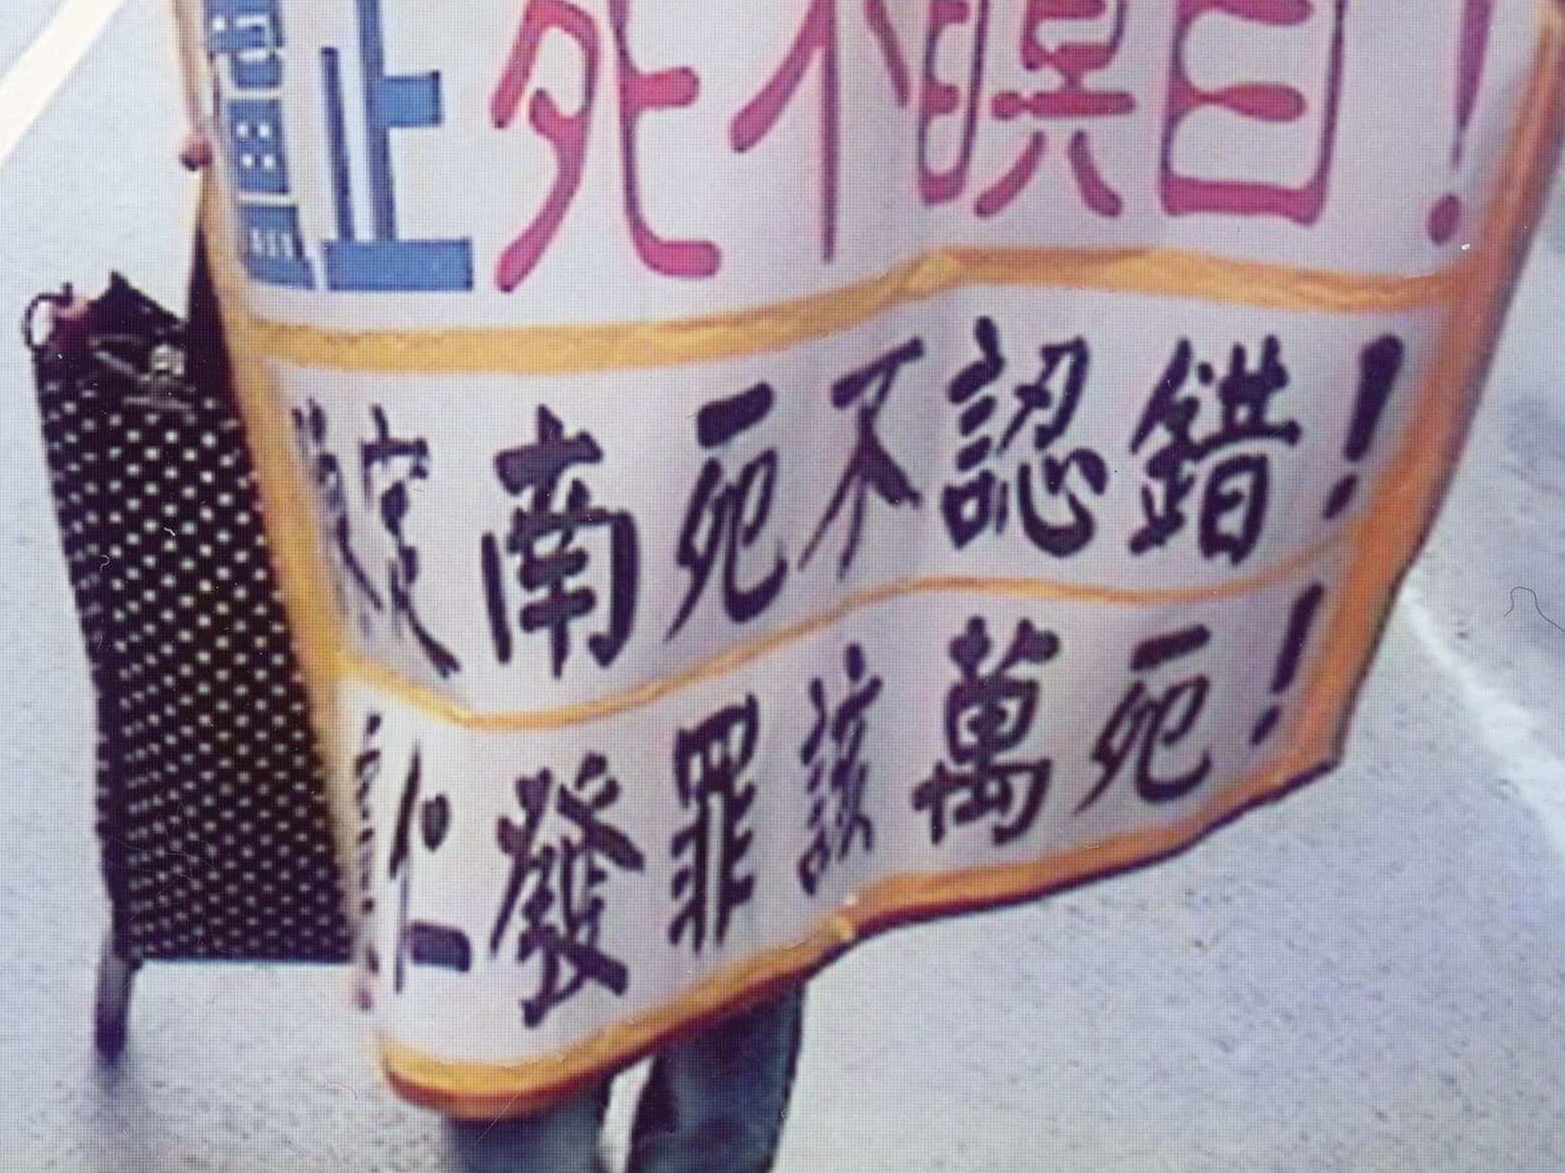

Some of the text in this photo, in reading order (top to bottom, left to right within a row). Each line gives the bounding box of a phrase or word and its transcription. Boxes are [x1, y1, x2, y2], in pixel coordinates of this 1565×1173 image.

[352, 582, 1326, 1029] 仁發罪該萬死!
